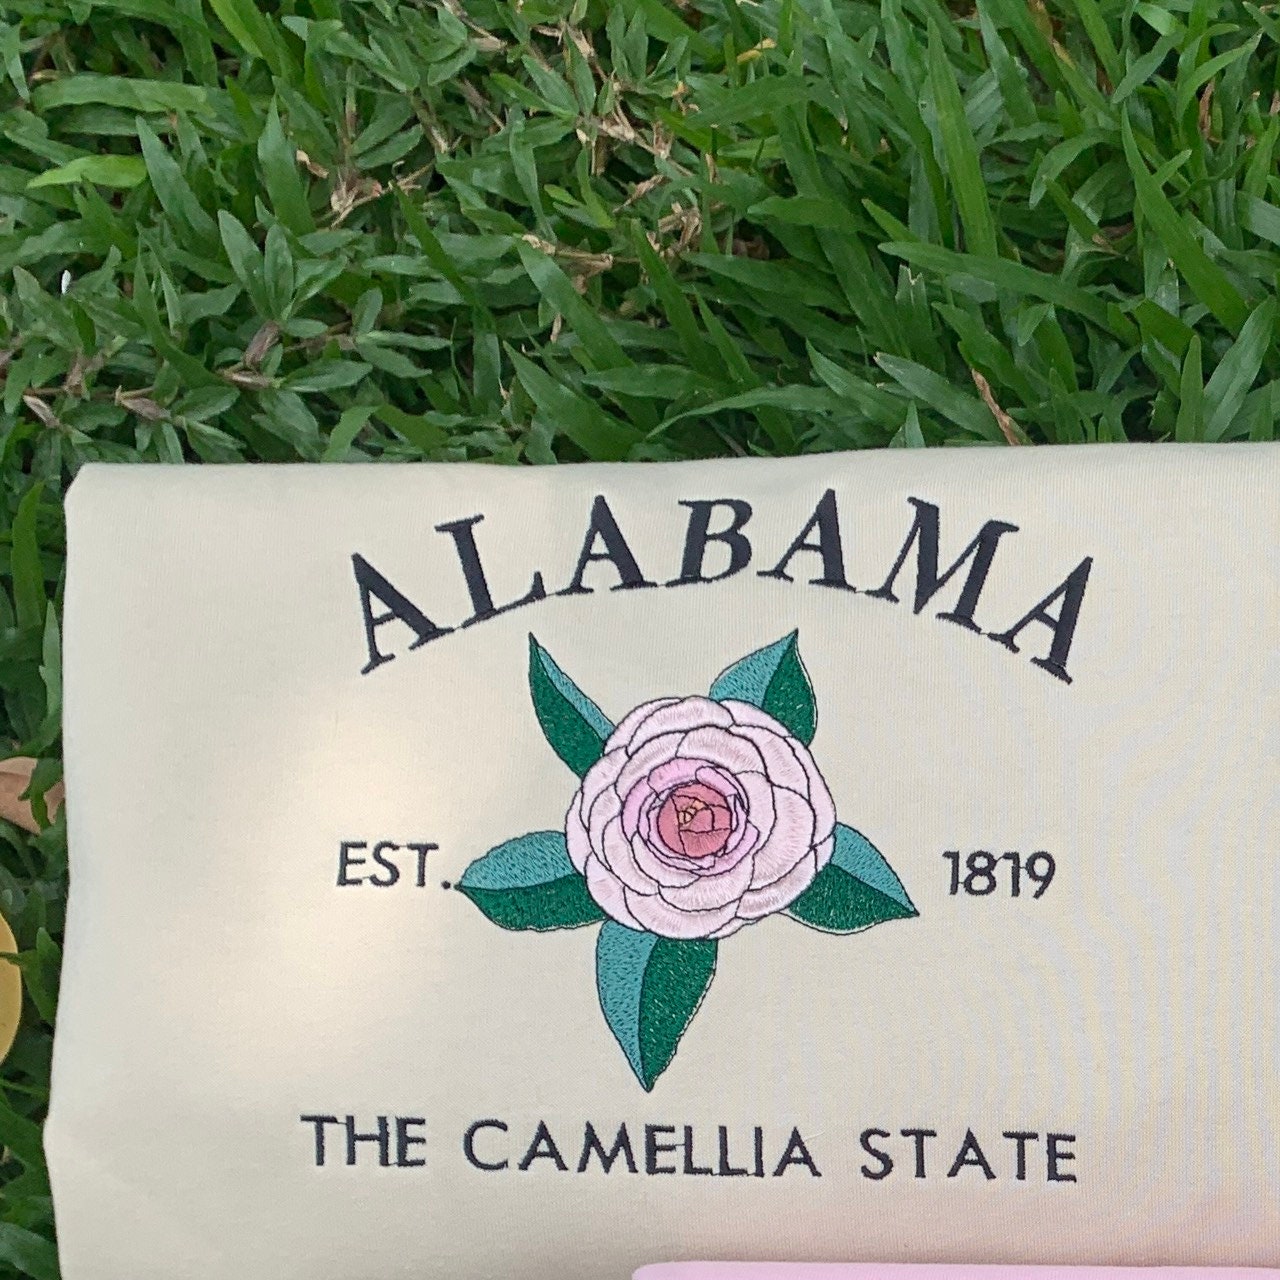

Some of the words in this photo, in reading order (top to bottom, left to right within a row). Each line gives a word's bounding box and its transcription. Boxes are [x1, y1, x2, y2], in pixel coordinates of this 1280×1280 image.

[352, 489, 1093, 684] ALABAMA
[338, 842, 450, 889] EST.
[943, 851, 1055, 899] 1819
[301, 1116, 426, 1167] THE
[464, 1119, 822, 1178] CAMELLIA
[860, 1128, 1077, 1183] STATE
